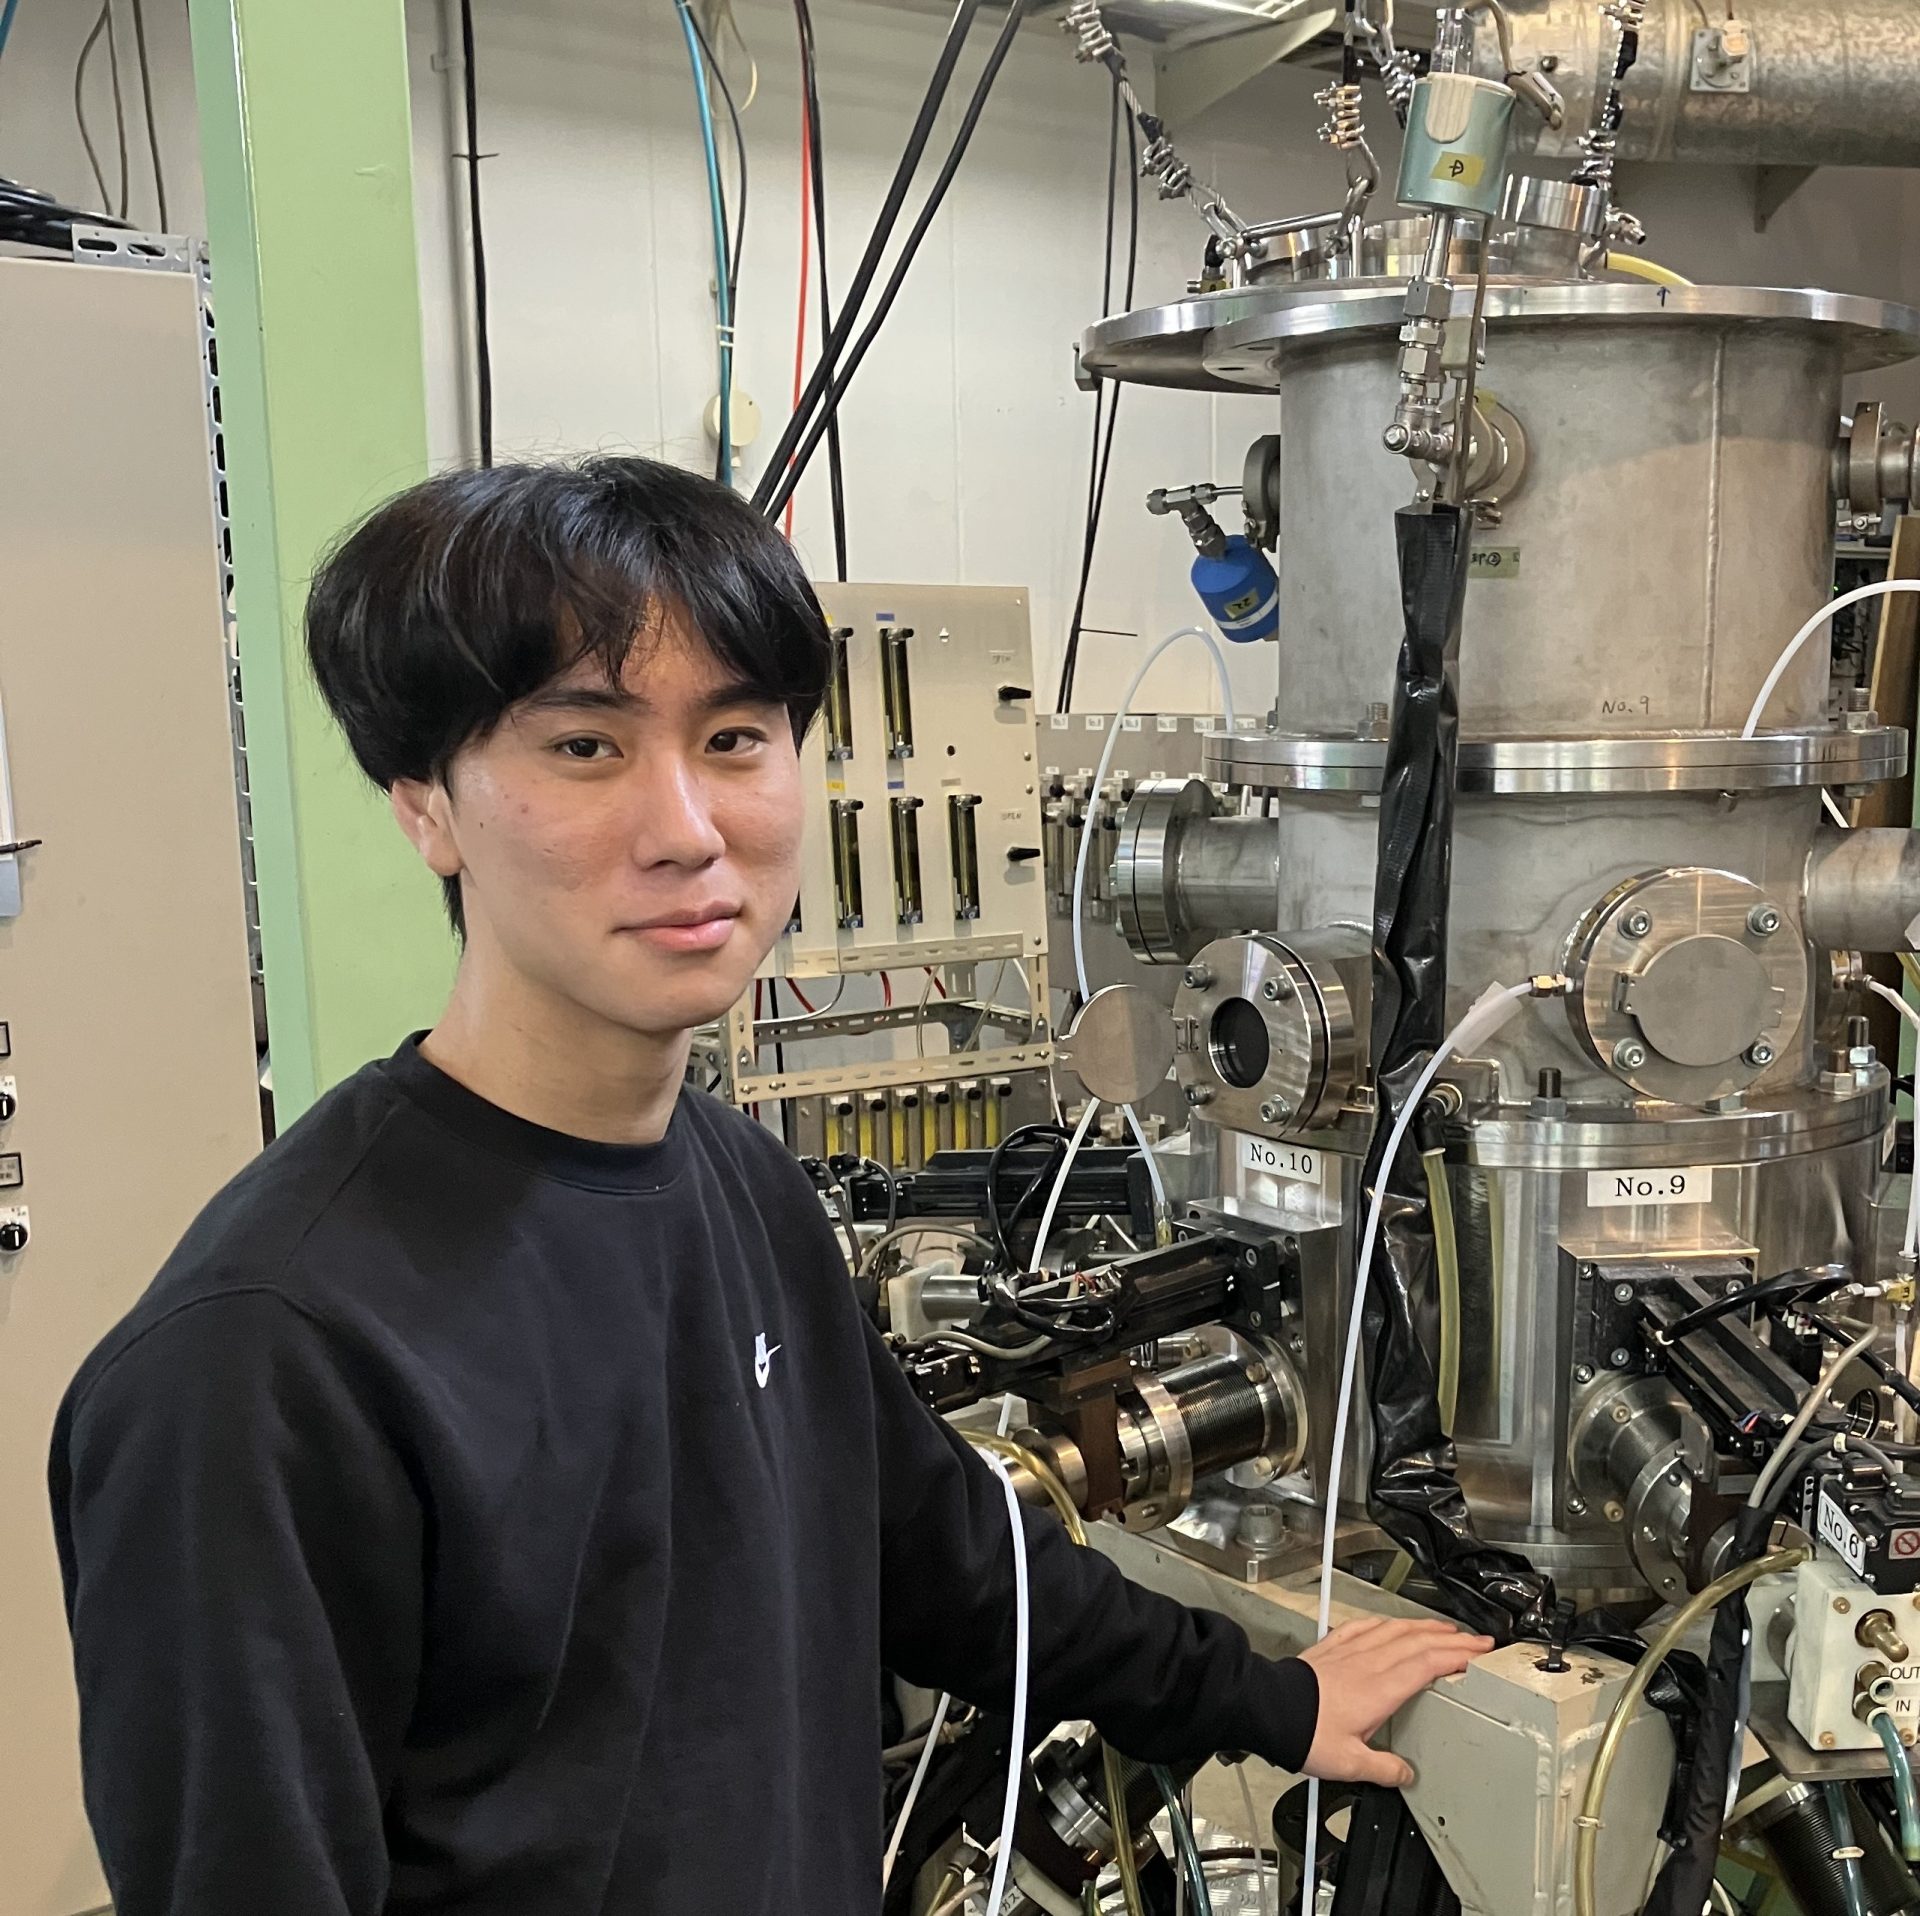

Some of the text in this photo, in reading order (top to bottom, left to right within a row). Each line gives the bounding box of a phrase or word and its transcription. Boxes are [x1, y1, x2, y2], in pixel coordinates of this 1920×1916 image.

[1250, 1142, 1312, 1174] No.10
[1615, 1174, 1685, 1197] No.9
[1823, 1503, 1859, 1559] No.6
[1890, 1666, 1920, 1680] OUT
[1895, 1699, 1911, 1713] IN
